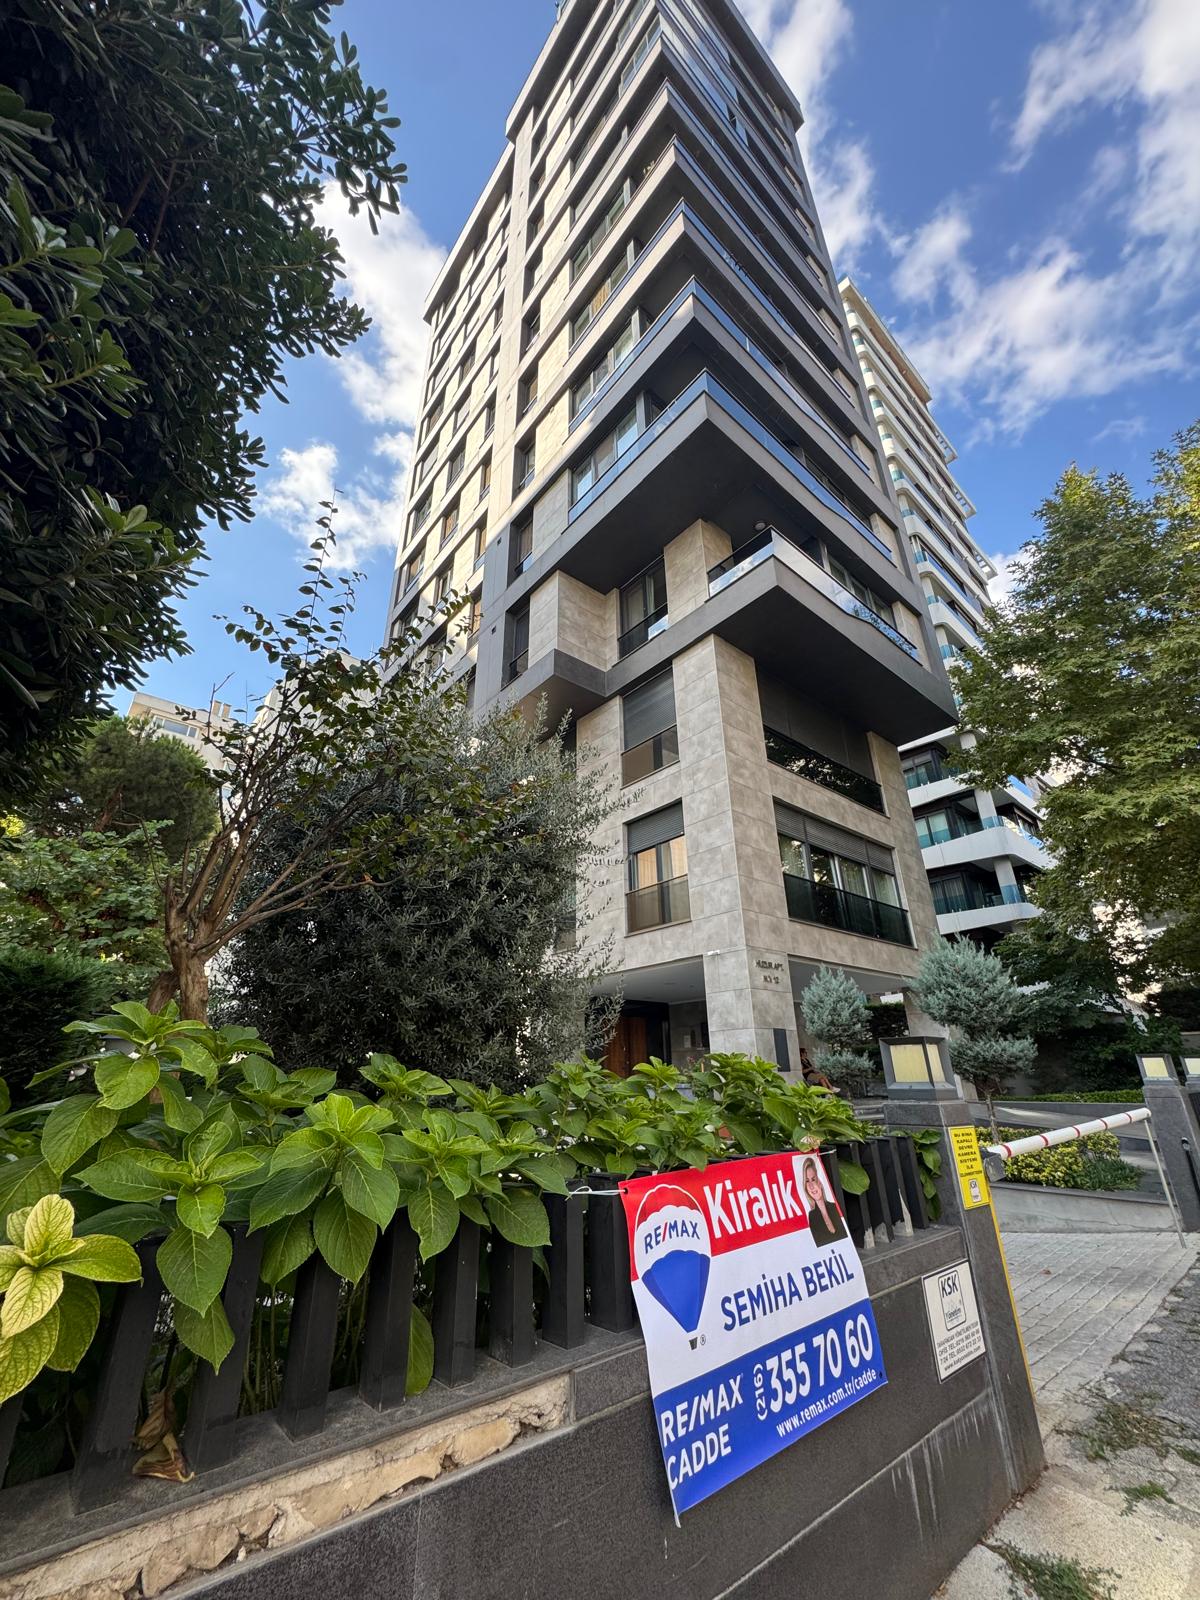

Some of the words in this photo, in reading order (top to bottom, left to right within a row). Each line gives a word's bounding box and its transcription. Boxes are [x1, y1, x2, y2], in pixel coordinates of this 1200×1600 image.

[643, 1219, 701, 1254] RE/MAX
[704, 1170, 803, 1239] Kiralık
[721, 1273, 802, 1332] SEMİHA
[801, 1249, 855, 1298] BEKİL
[940, 1273, 959, 1298] KSK
[752, 1363, 768, 1422] (216)
[765, 1342, 811, 1413] 355
[813, 1328, 842, 1387] 70
[844, 1313, 873, 1368] 60
[660, 1374, 744, 1448] RE/MAX
[776, 1368, 877, 1438] www.remax.com.tr/cadde
[666, 1423, 732, 1491] CADDE
